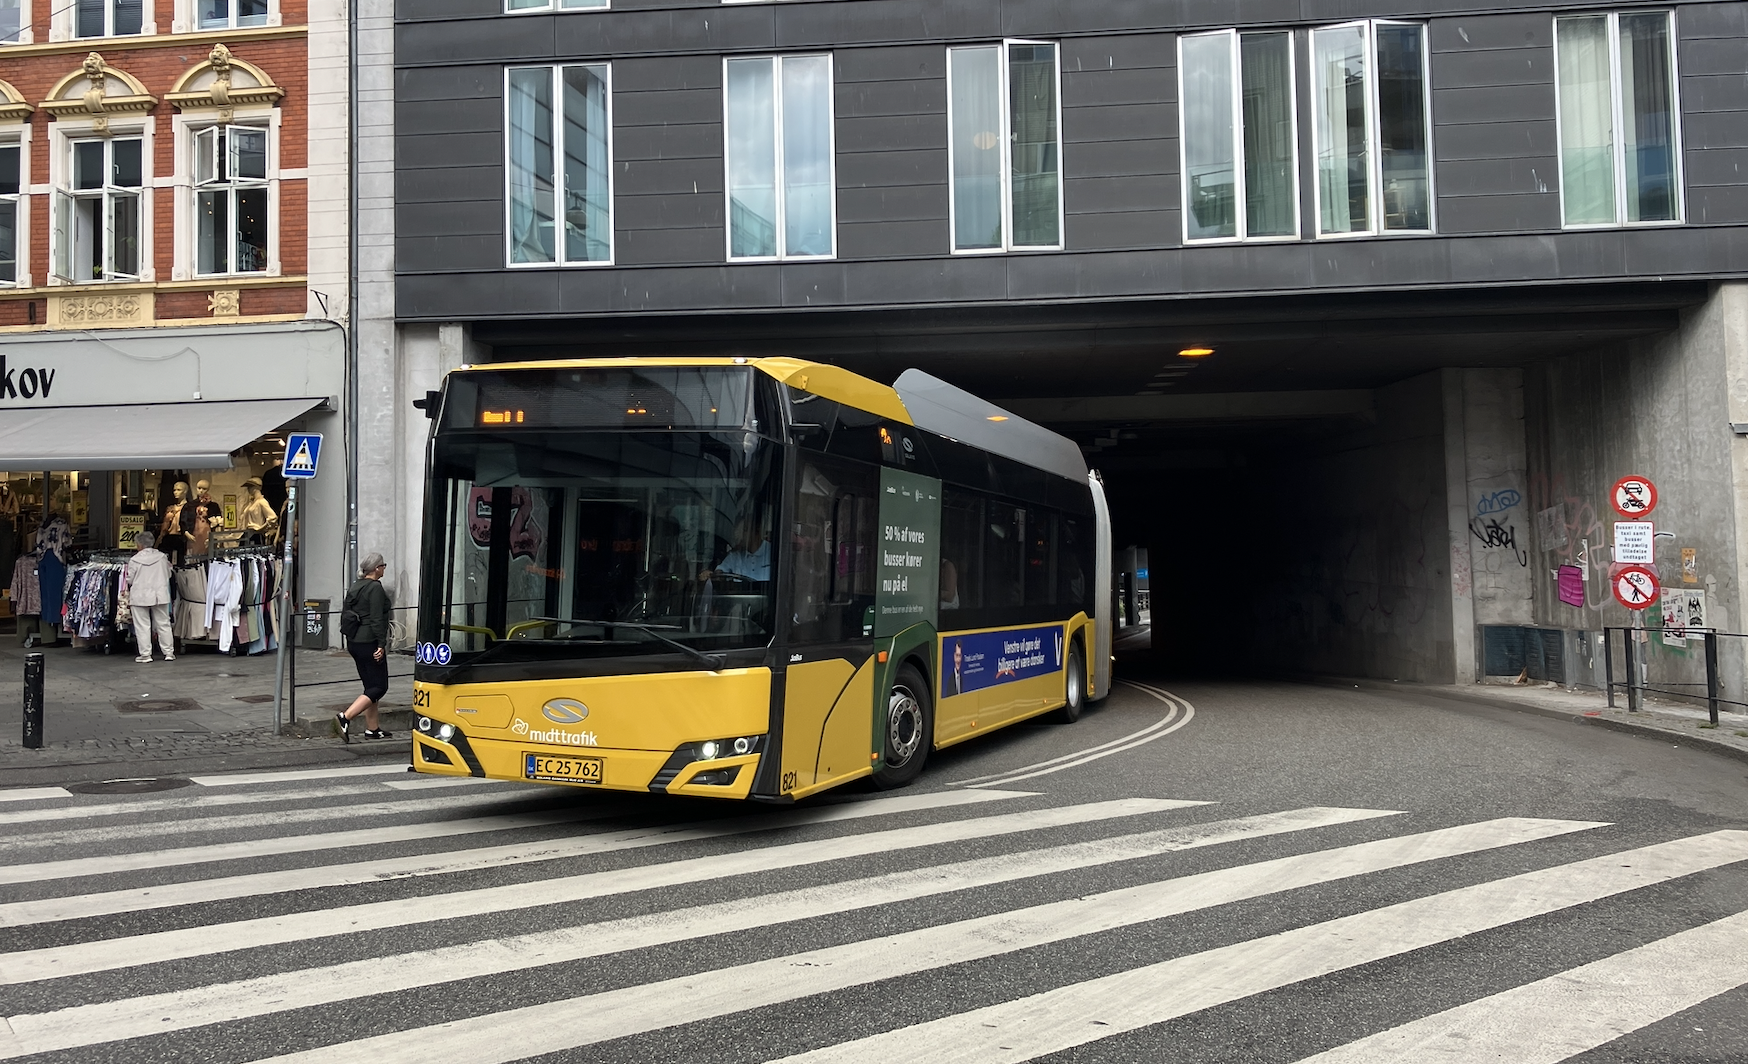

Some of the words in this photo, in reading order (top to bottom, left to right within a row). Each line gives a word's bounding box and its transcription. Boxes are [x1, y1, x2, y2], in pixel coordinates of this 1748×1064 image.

[885, 525, 894, 541] 50
[894, 526, 901, 541] %
[901, 526, 908, 542] af
[908, 531, 925, 543] vores
[884, 550, 906, 567] busser
[906, 551, 923, 568] kører
[883, 579, 892, 592] nu
[892, 574, 901, 595] på
[901, 576, 908, 592] el
[1004, 640, 1020, 654] Venstre
[1055, 631, 1062, 666] V
[413, 688, 430, 708] 821
[529, 728, 598, 746] midttrafik
[536, 759, 553, 773] EC
[556, 761, 571, 775] 25
[575, 761, 599, 777] 762
[782, 770, 797, 791] 821
